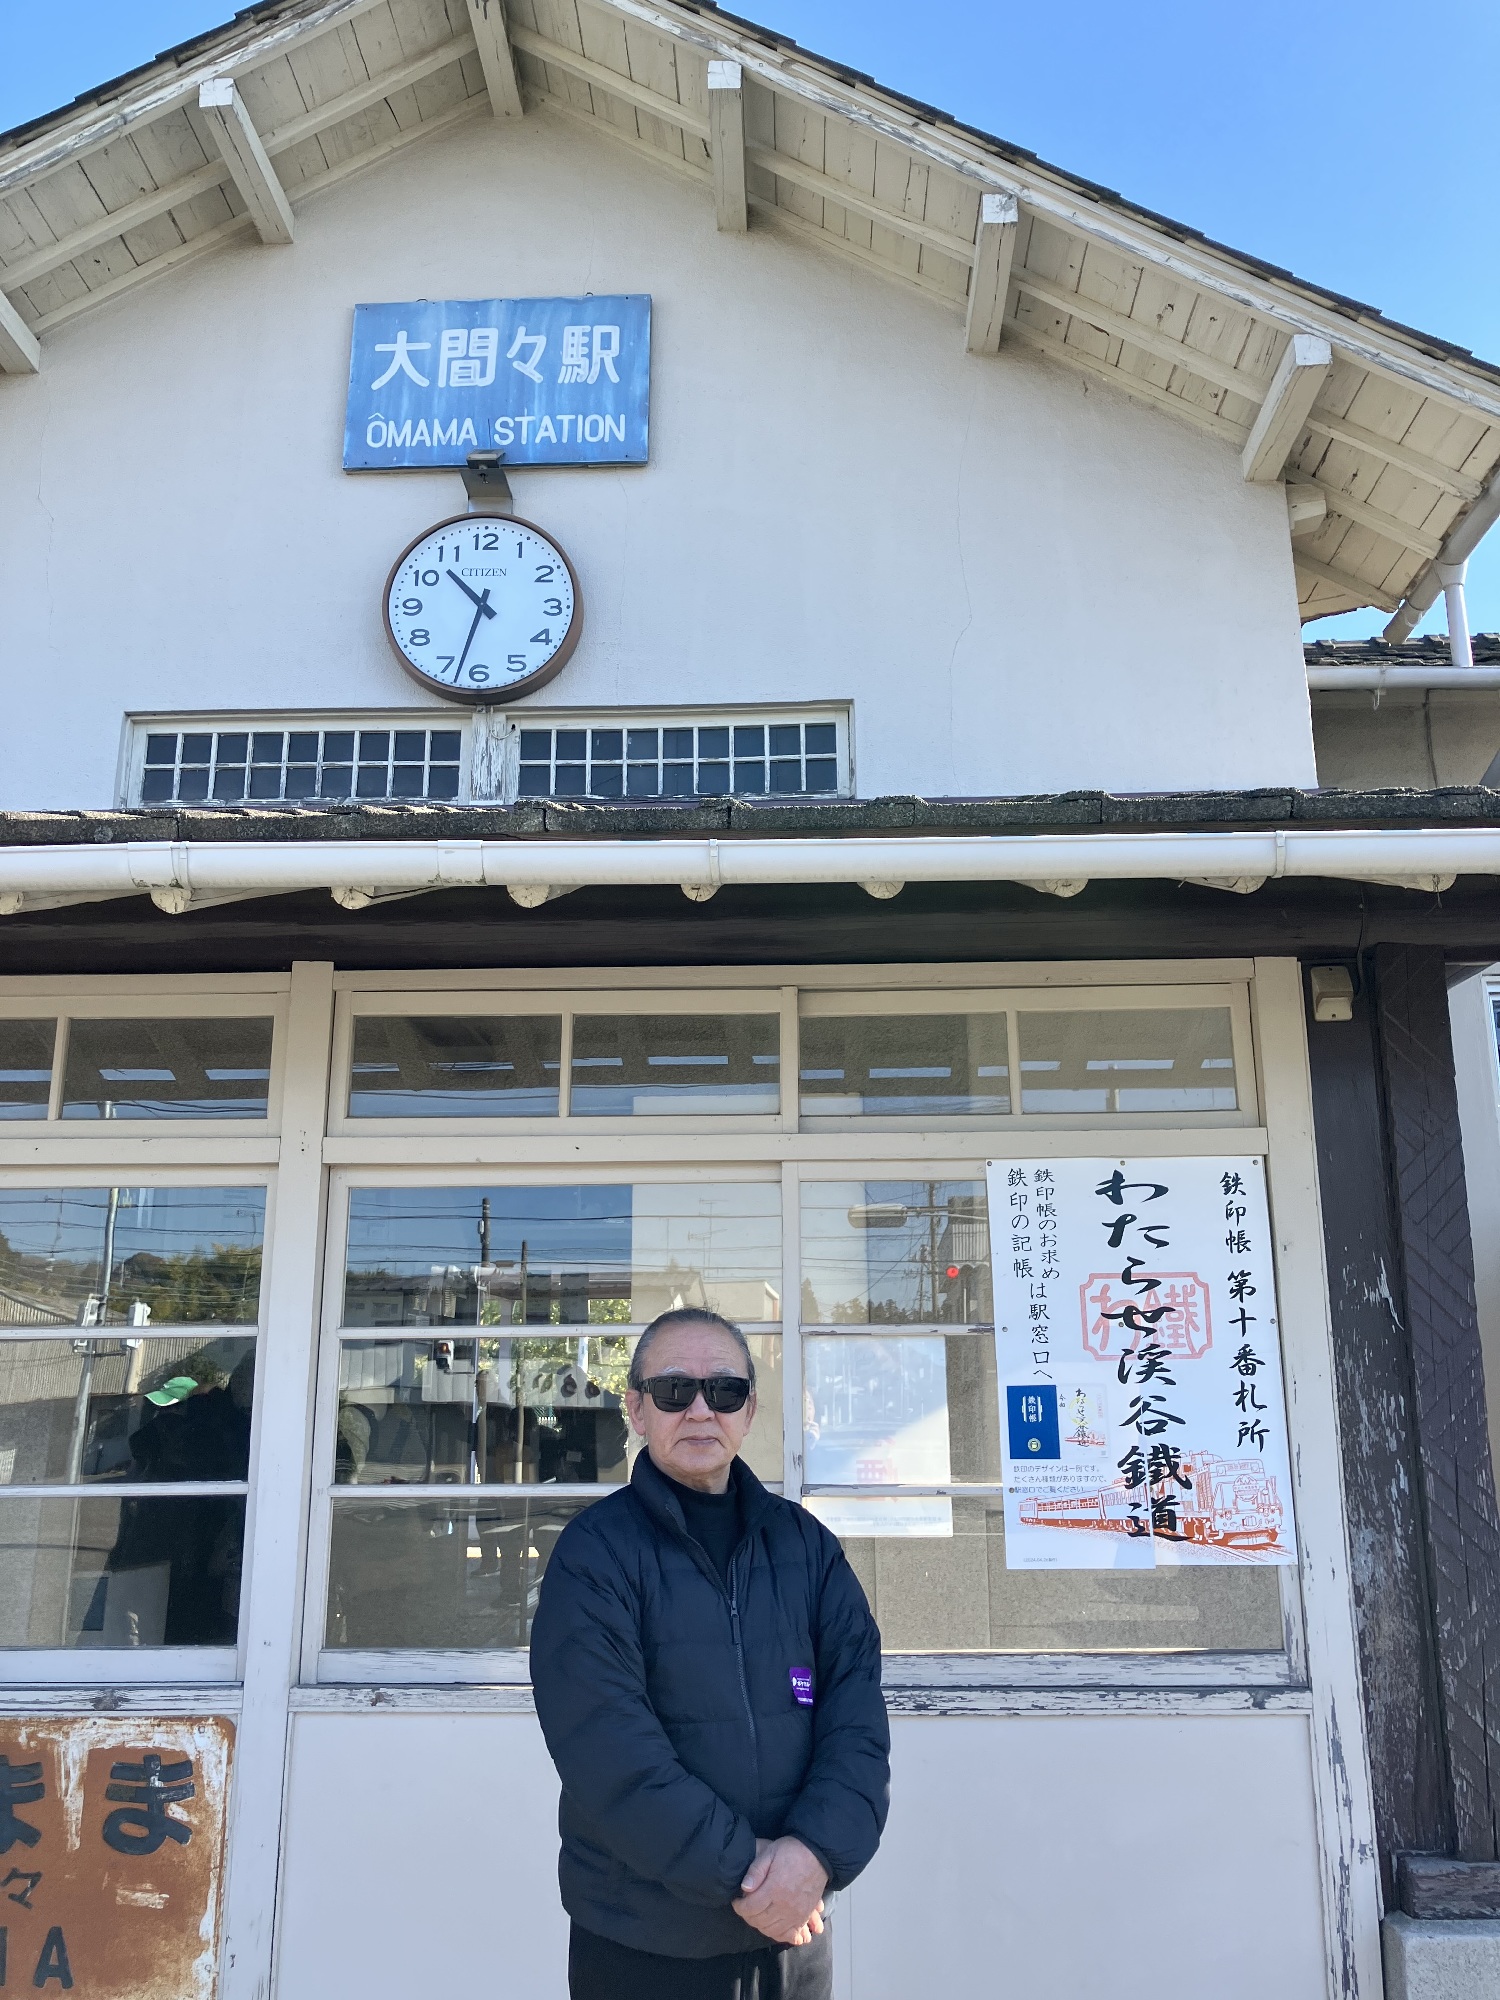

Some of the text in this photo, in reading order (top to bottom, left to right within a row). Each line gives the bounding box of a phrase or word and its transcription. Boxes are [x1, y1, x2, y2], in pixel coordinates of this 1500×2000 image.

[370, 325, 621, 391] 大間々駅
[366, 412, 626, 448] ÔMAMA STATION
[473, 533, 499, 551] 12
[516, 541, 523, 559] 1
[438, 545, 461, 563] 11
[413, 569, 440, 587] 10
[461, 567, 508, 577] CITIZEN
[534, 565, 555, 583] 2
[402, 597, 423, 616] 9
[543, 598, 563, 616] 3
[409, 628, 431, 646] 8
[529, 628, 553, 646] 4
[436, 655, 456, 674] 7
[506, 654, 527, 672] 5
[468, 664, 490, 682] 6
[1219, 1171, 1252, 1254] 鉄印帳
[1227, 1270, 1270, 1452] 第十番札所
[0, 1925, 74, 1990] A
